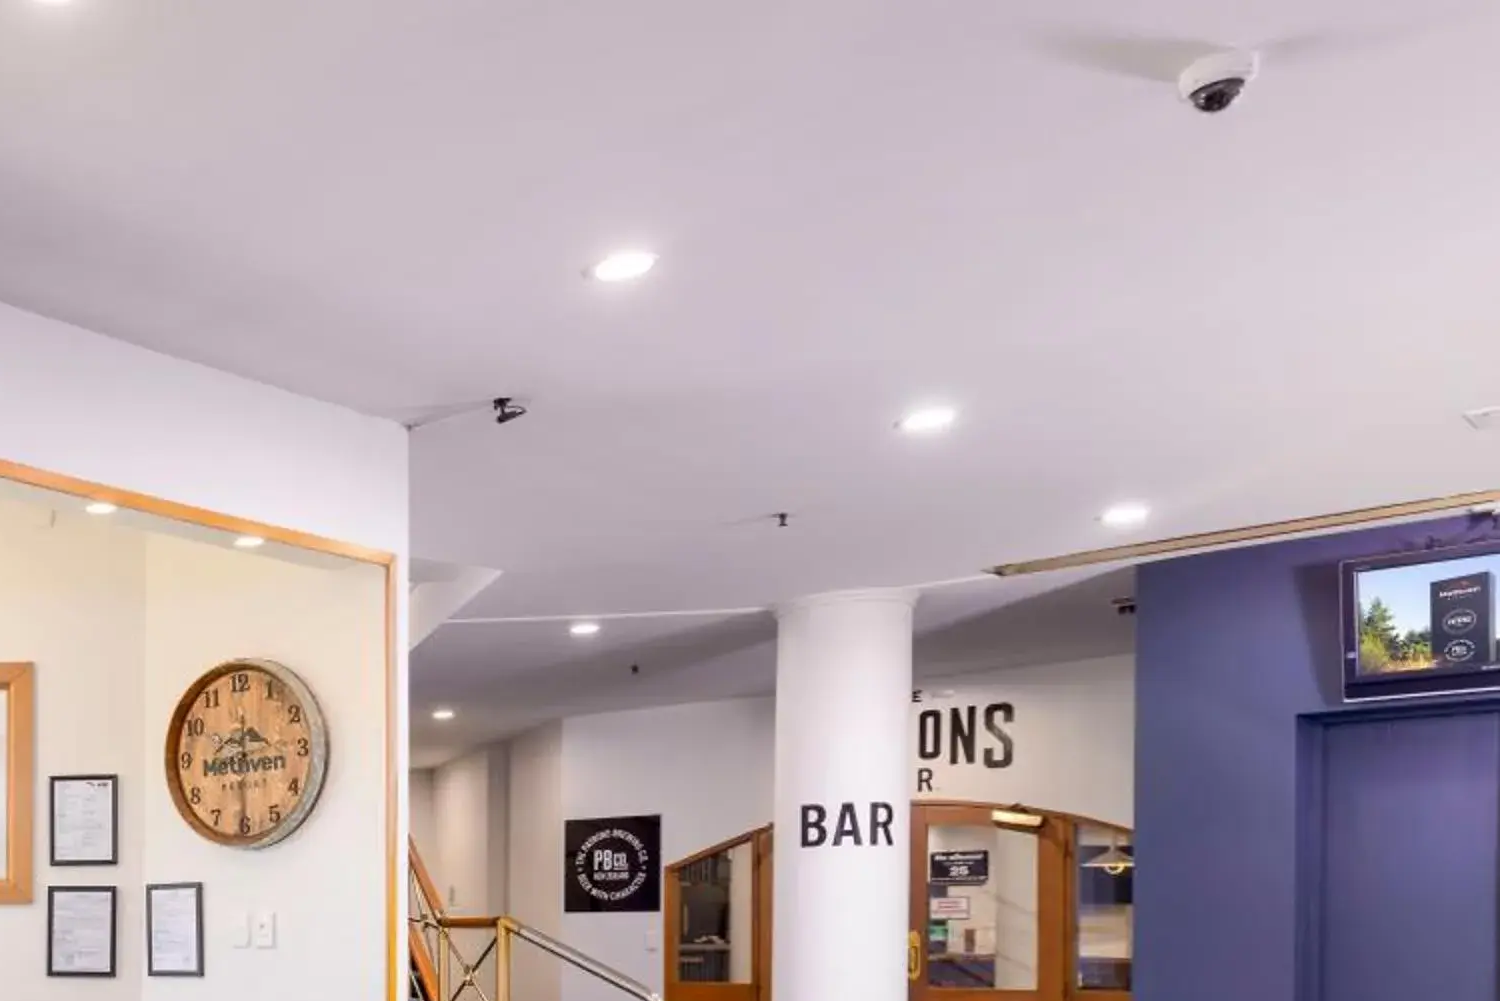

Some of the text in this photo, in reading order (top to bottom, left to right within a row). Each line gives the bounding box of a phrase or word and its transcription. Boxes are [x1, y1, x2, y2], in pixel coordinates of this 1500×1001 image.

[230, 673, 250, 692] 12
[265, 680, 274, 699] 1
[203, 689, 220, 708] 11
[287, 704, 301, 724] 2
[186, 718, 204, 737] 10
[919, 702, 1014, 769] ONS
[297, 738, 309, 757] 3
[181, 751, 193, 769] 9
[190, 787, 202, 805] 8
[287, 778, 300, 796] 4
[210, 809, 222, 826] 7
[268, 804, 281, 823] 5
[240, 815, 251, 835] 6
[801, 802, 893, 848] BAR
